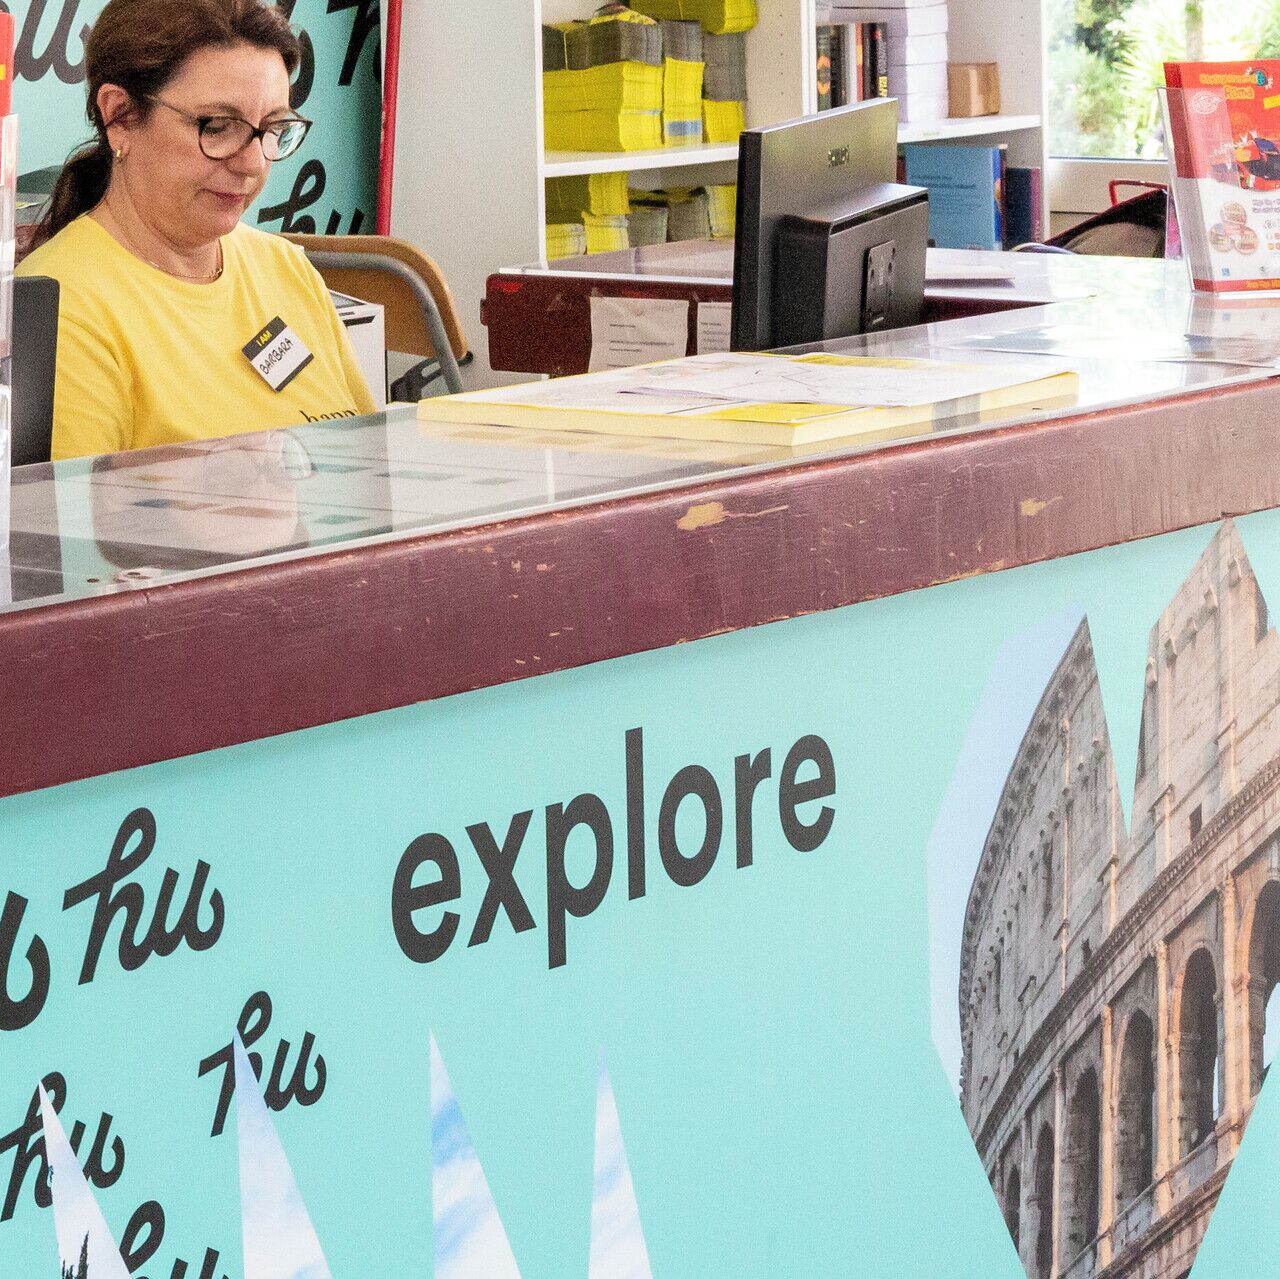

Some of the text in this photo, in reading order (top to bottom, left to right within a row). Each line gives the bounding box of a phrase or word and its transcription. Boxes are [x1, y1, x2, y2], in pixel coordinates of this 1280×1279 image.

[259, 337, 293, 375] BARBARA
[260, 330, 273, 345] AM
[62, 807, 226, 985] hu
[391, 726, 837, 970] explore
